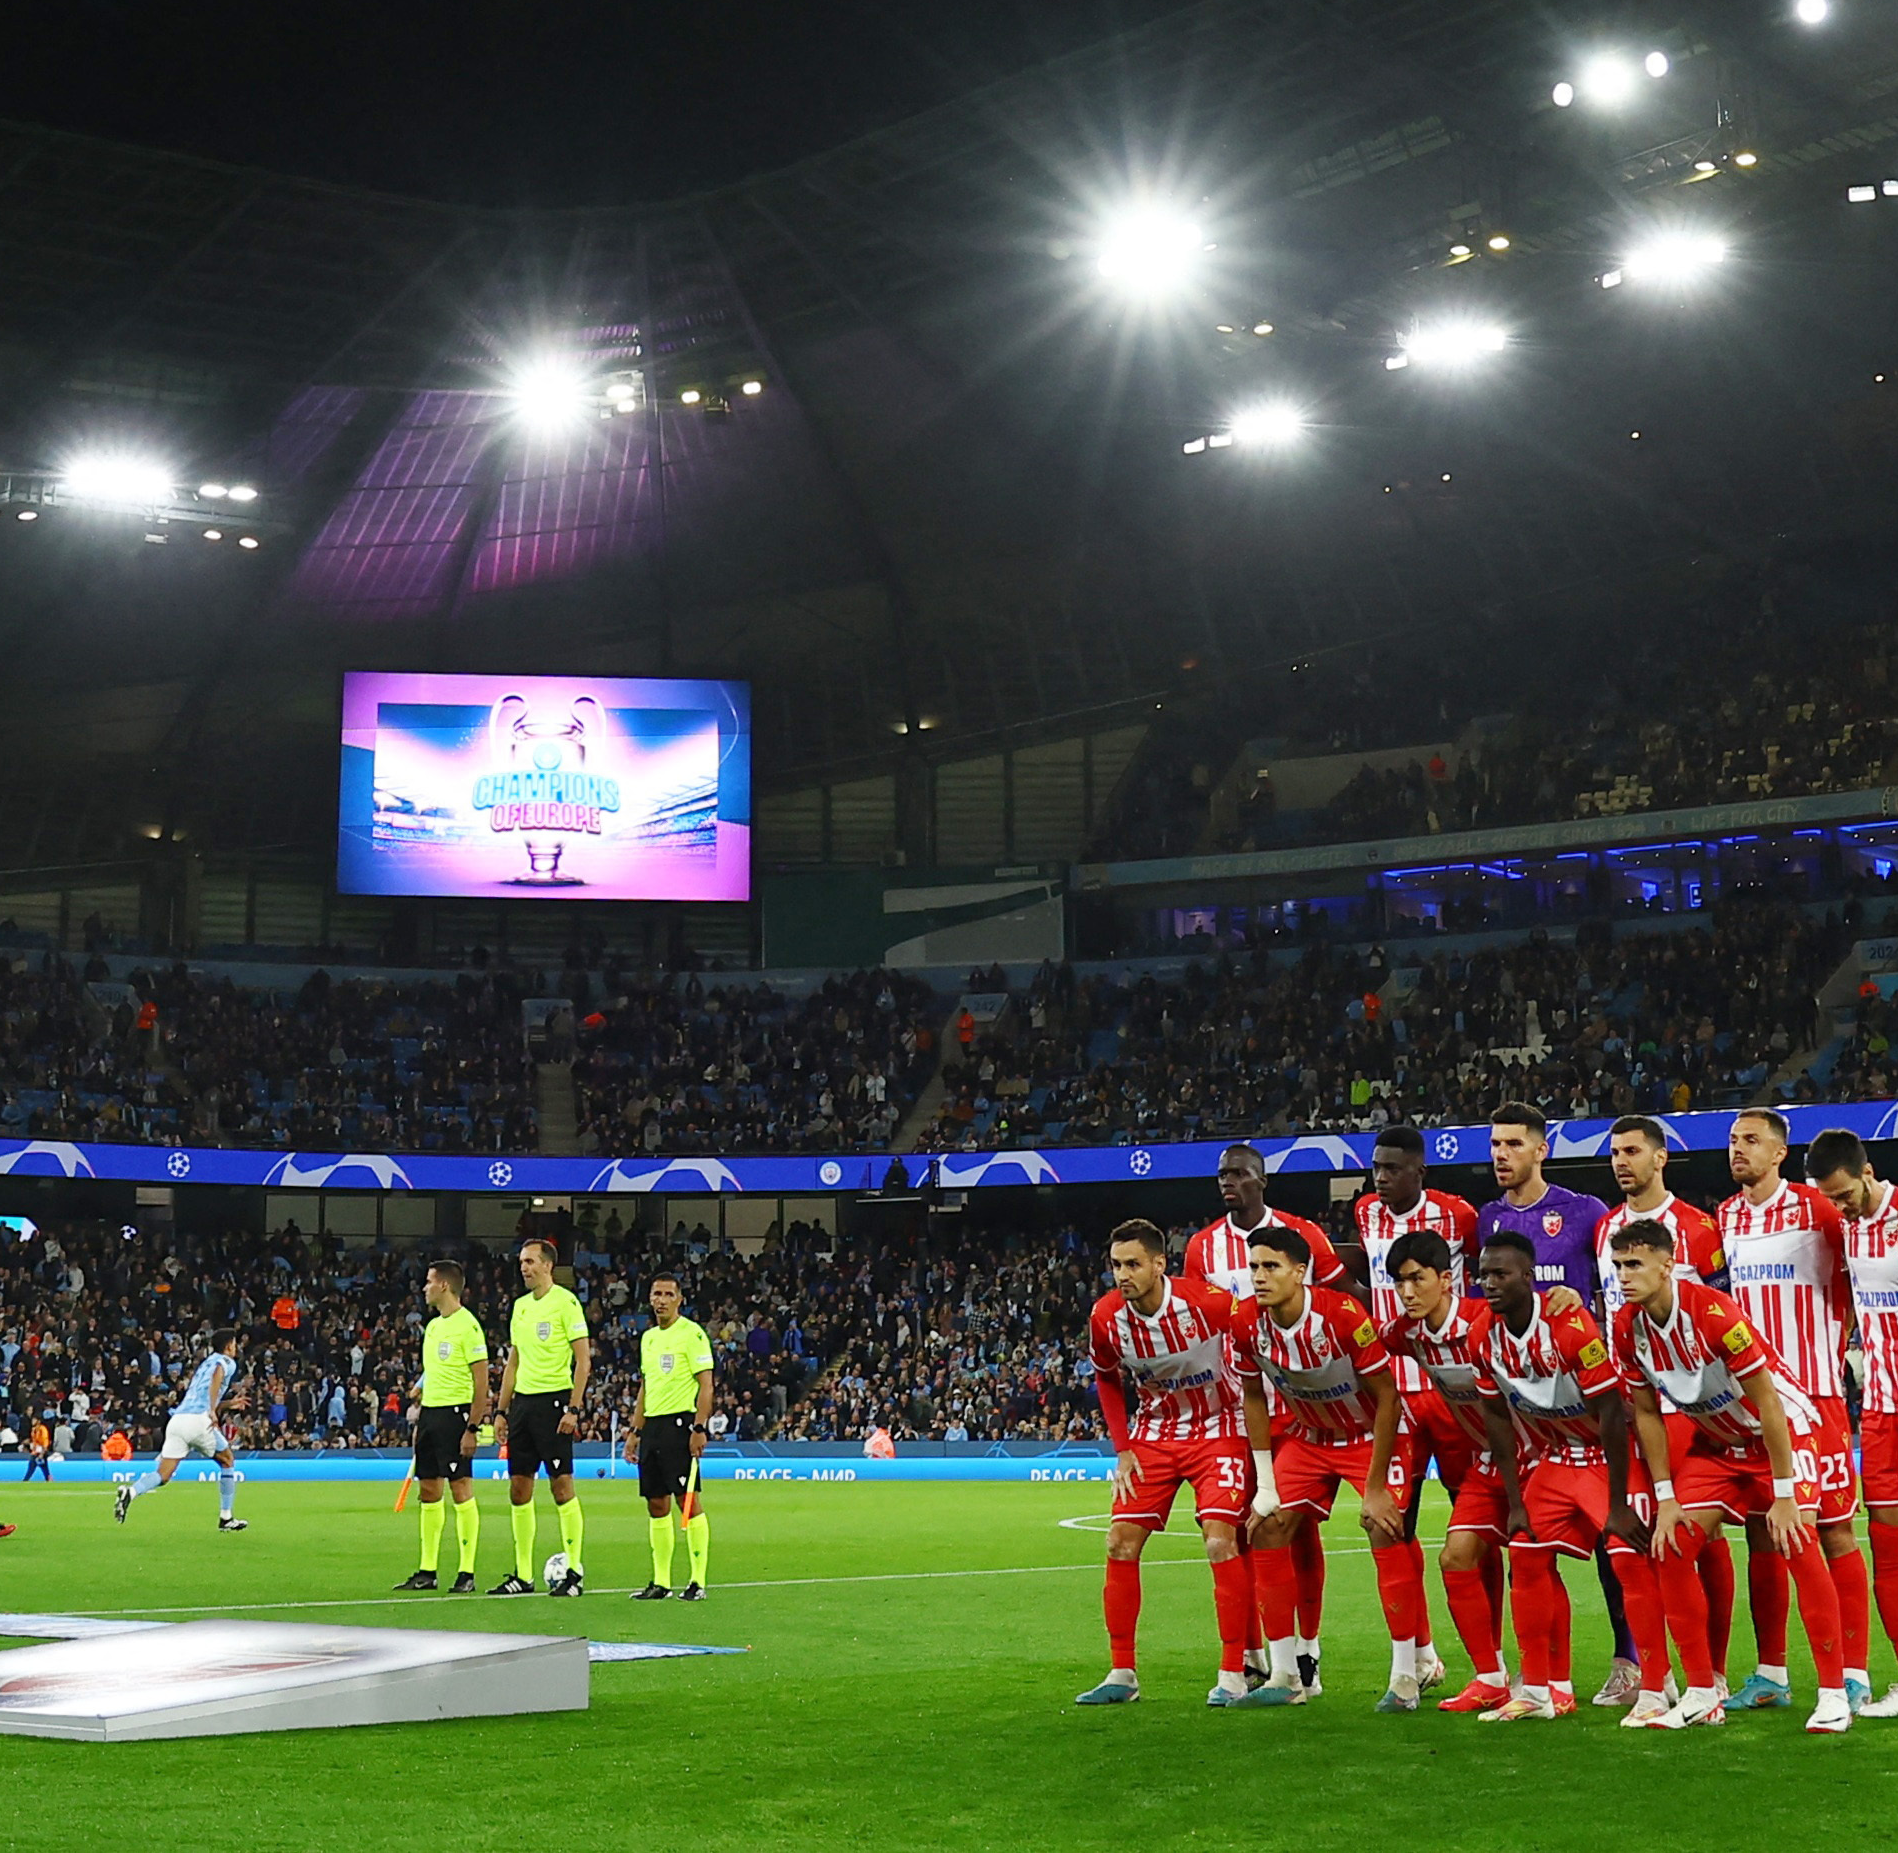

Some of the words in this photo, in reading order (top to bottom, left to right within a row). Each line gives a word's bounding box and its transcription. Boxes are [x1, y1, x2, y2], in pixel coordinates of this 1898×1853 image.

[472, 769, 621, 812] CHAMPIONS
[490, 805, 518, 832] OF
[519, 802, 602, 834] EUROPE
[1739, 1264, 1795, 1282] GAZPROM
[1216, 1457, 1245, 1490] 33
[1820, 1452, 1849, 1491] 23
